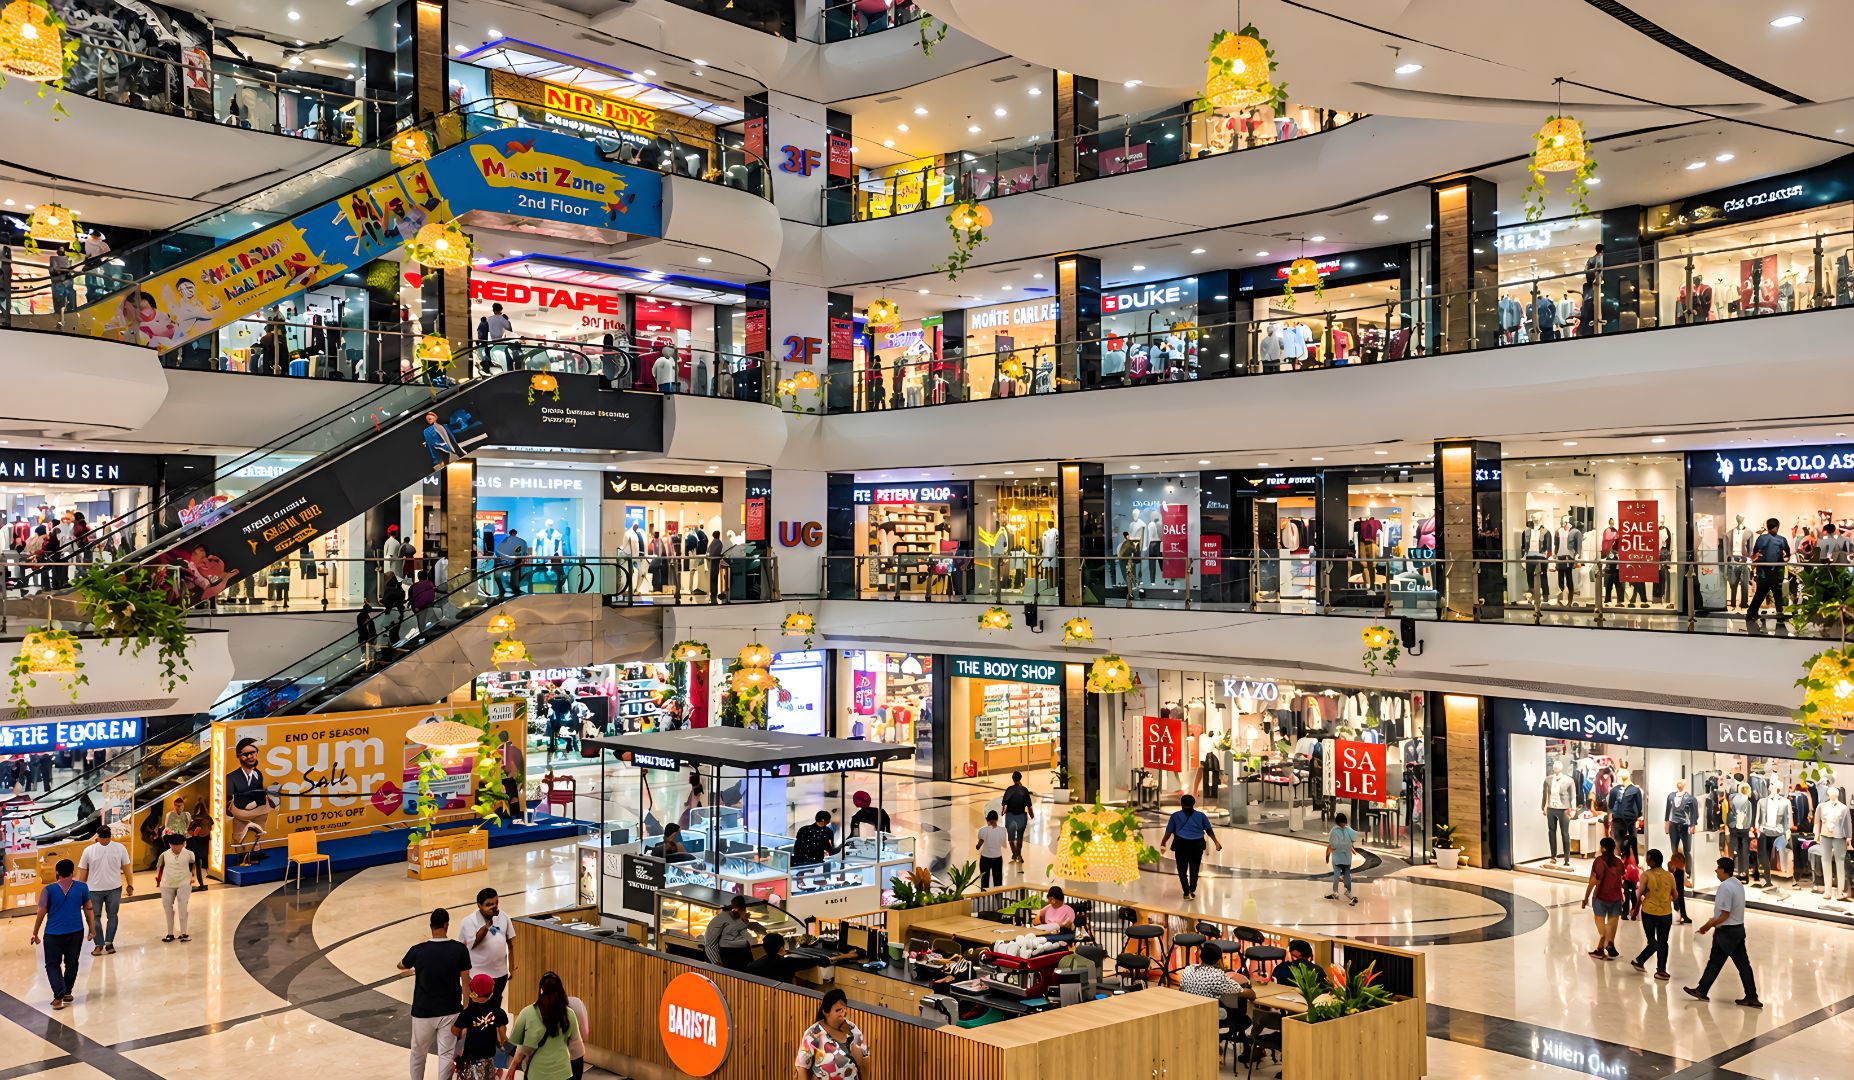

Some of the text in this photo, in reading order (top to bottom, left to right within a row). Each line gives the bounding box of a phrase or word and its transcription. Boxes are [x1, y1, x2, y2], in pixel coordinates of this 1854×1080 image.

[778, 145, 821, 176] 3F
[518, 194, 589, 216] 2nd Floor
[1118, 286, 1180, 310] DUKE
[972, 309, 1009, 329] MONTE
[783, 335, 822, 364] 2F
[34, 457, 119, 479] HEUSEN
[1739, 457, 1772, 472] U.S.
[1775, 454, 1826, 471] POLO
[510, 478, 584, 490] PHILIPPE
[779, 521, 823, 547] UG
[1163, 524, 1186, 535] SALE
[1622, 521, 1653, 533] SALE
[956, 660, 1056, 680] THE BODY SHOP
[1222, 679, 1279, 701] KAZO
[1538, 711, 1580, 732] Allen
[285, 727, 369, 742] END OF SEASON
[1149, 723, 1174, 743] SA
[265, 737, 384, 777] sum
[1149, 744, 1174, 766] LE
[1343, 748, 1376, 771] SA
[798, 760, 834, 773] TIMEX
[1343, 771, 1376, 795] LE
[287, 814, 302, 824] UP
[305, 812, 318, 822] TO
[345, 807, 365, 817] OFF
[669, 1003, 717, 1047] BARISTA
